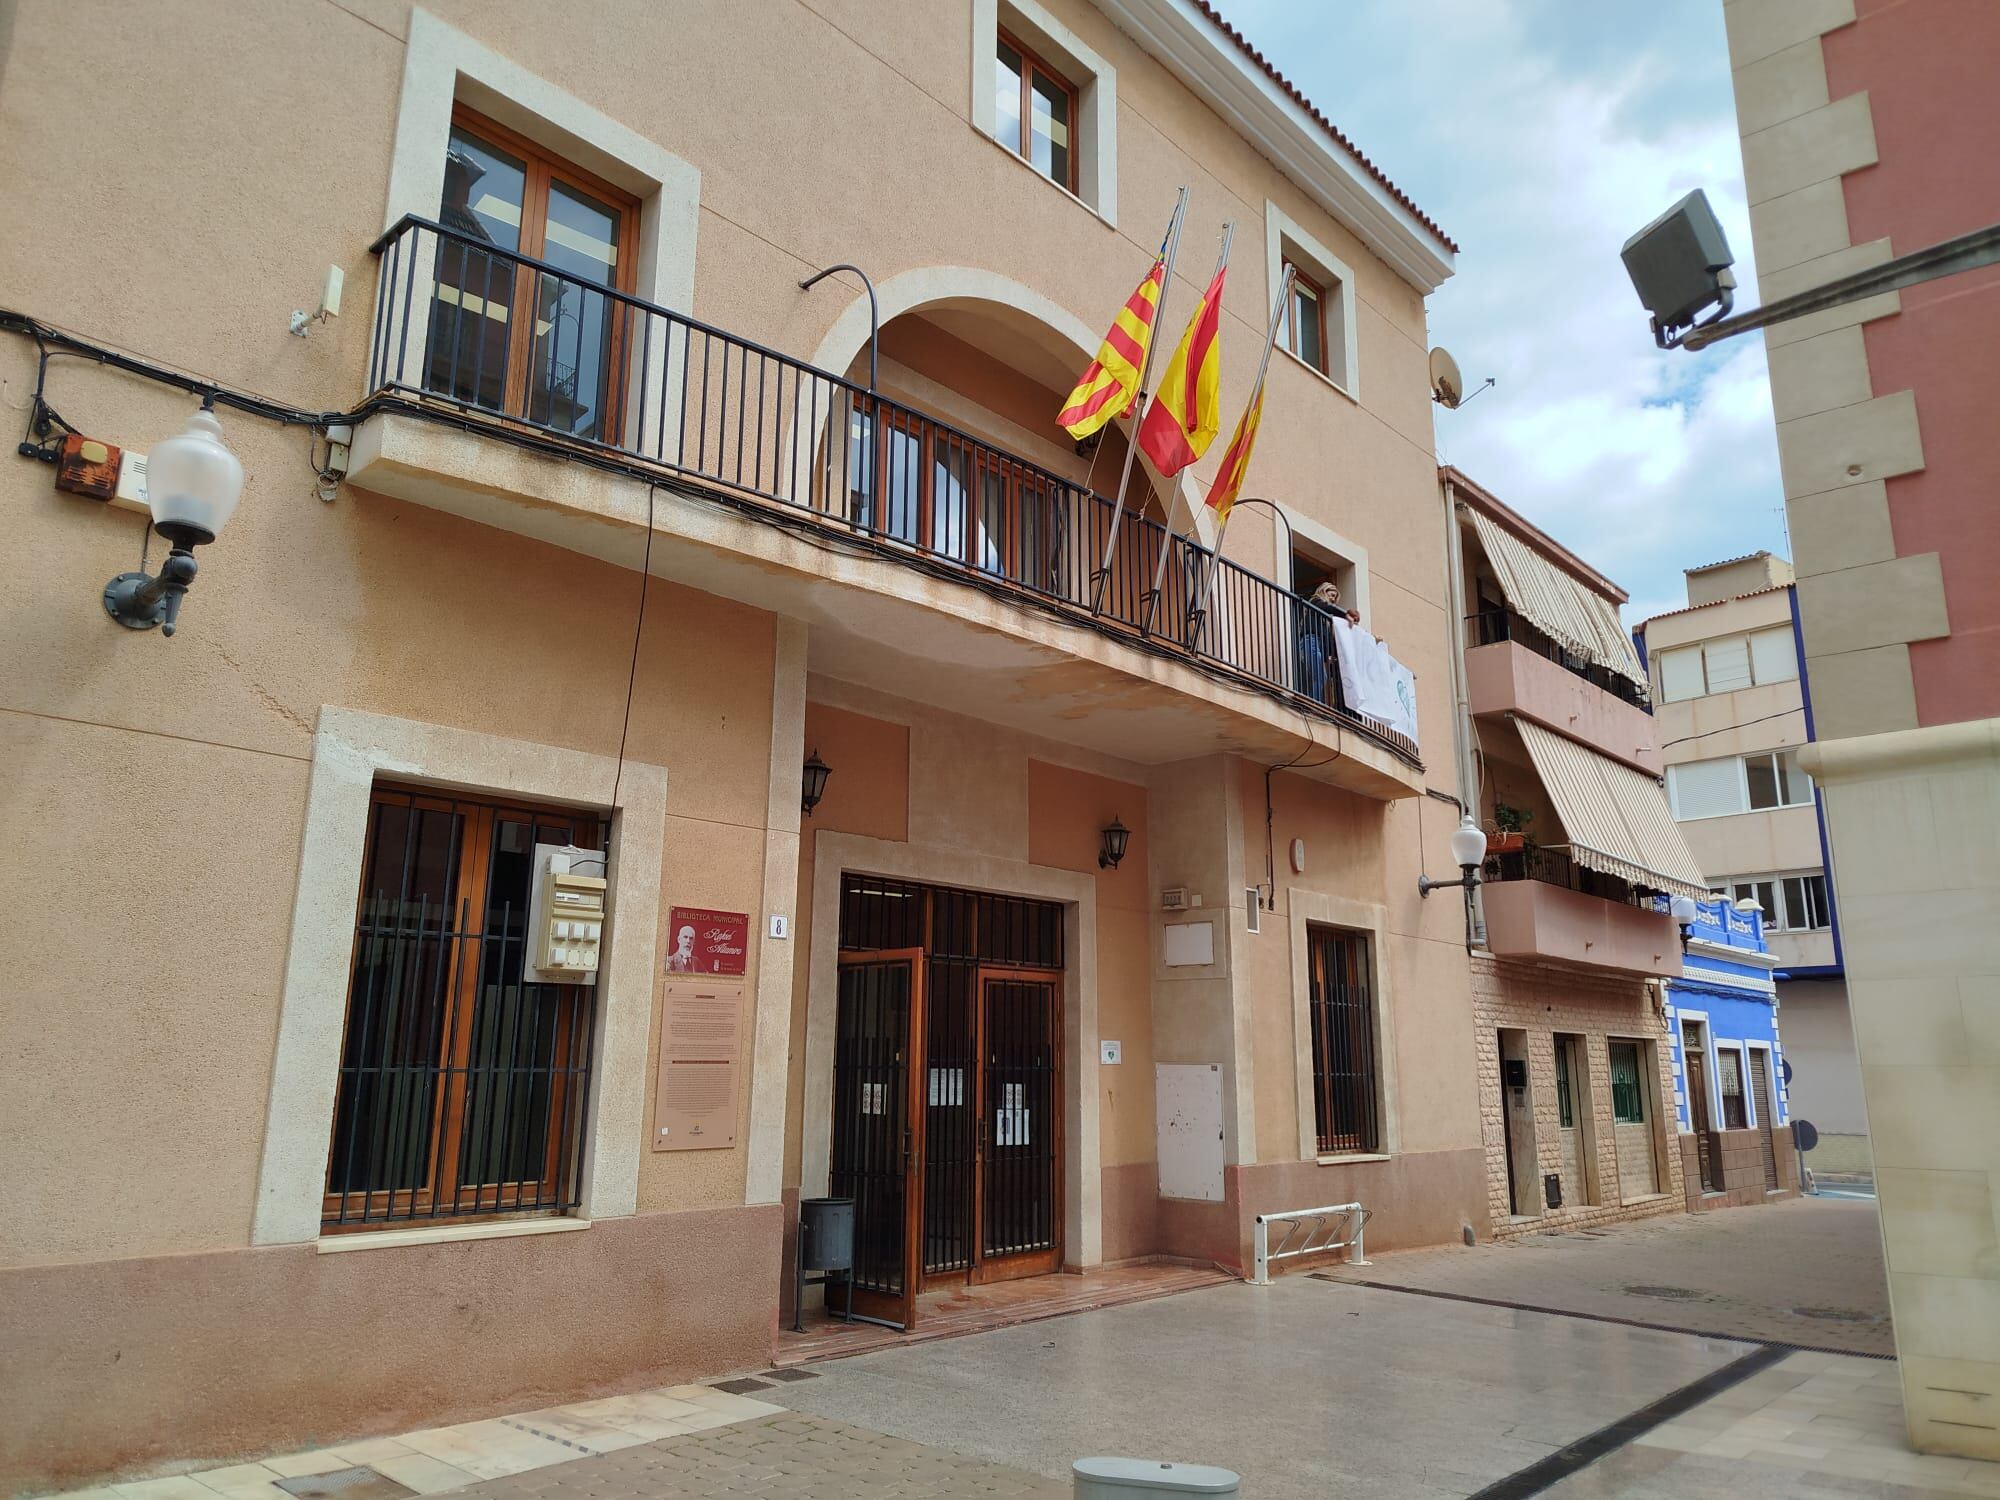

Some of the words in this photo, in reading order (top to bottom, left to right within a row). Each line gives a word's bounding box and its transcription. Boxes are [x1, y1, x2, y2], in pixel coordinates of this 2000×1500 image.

[676, 911, 711, 921] BIBLIOTECA
[713, 915, 744, 925] MUNICIPAL
[776, 919, 782, 935] 8
